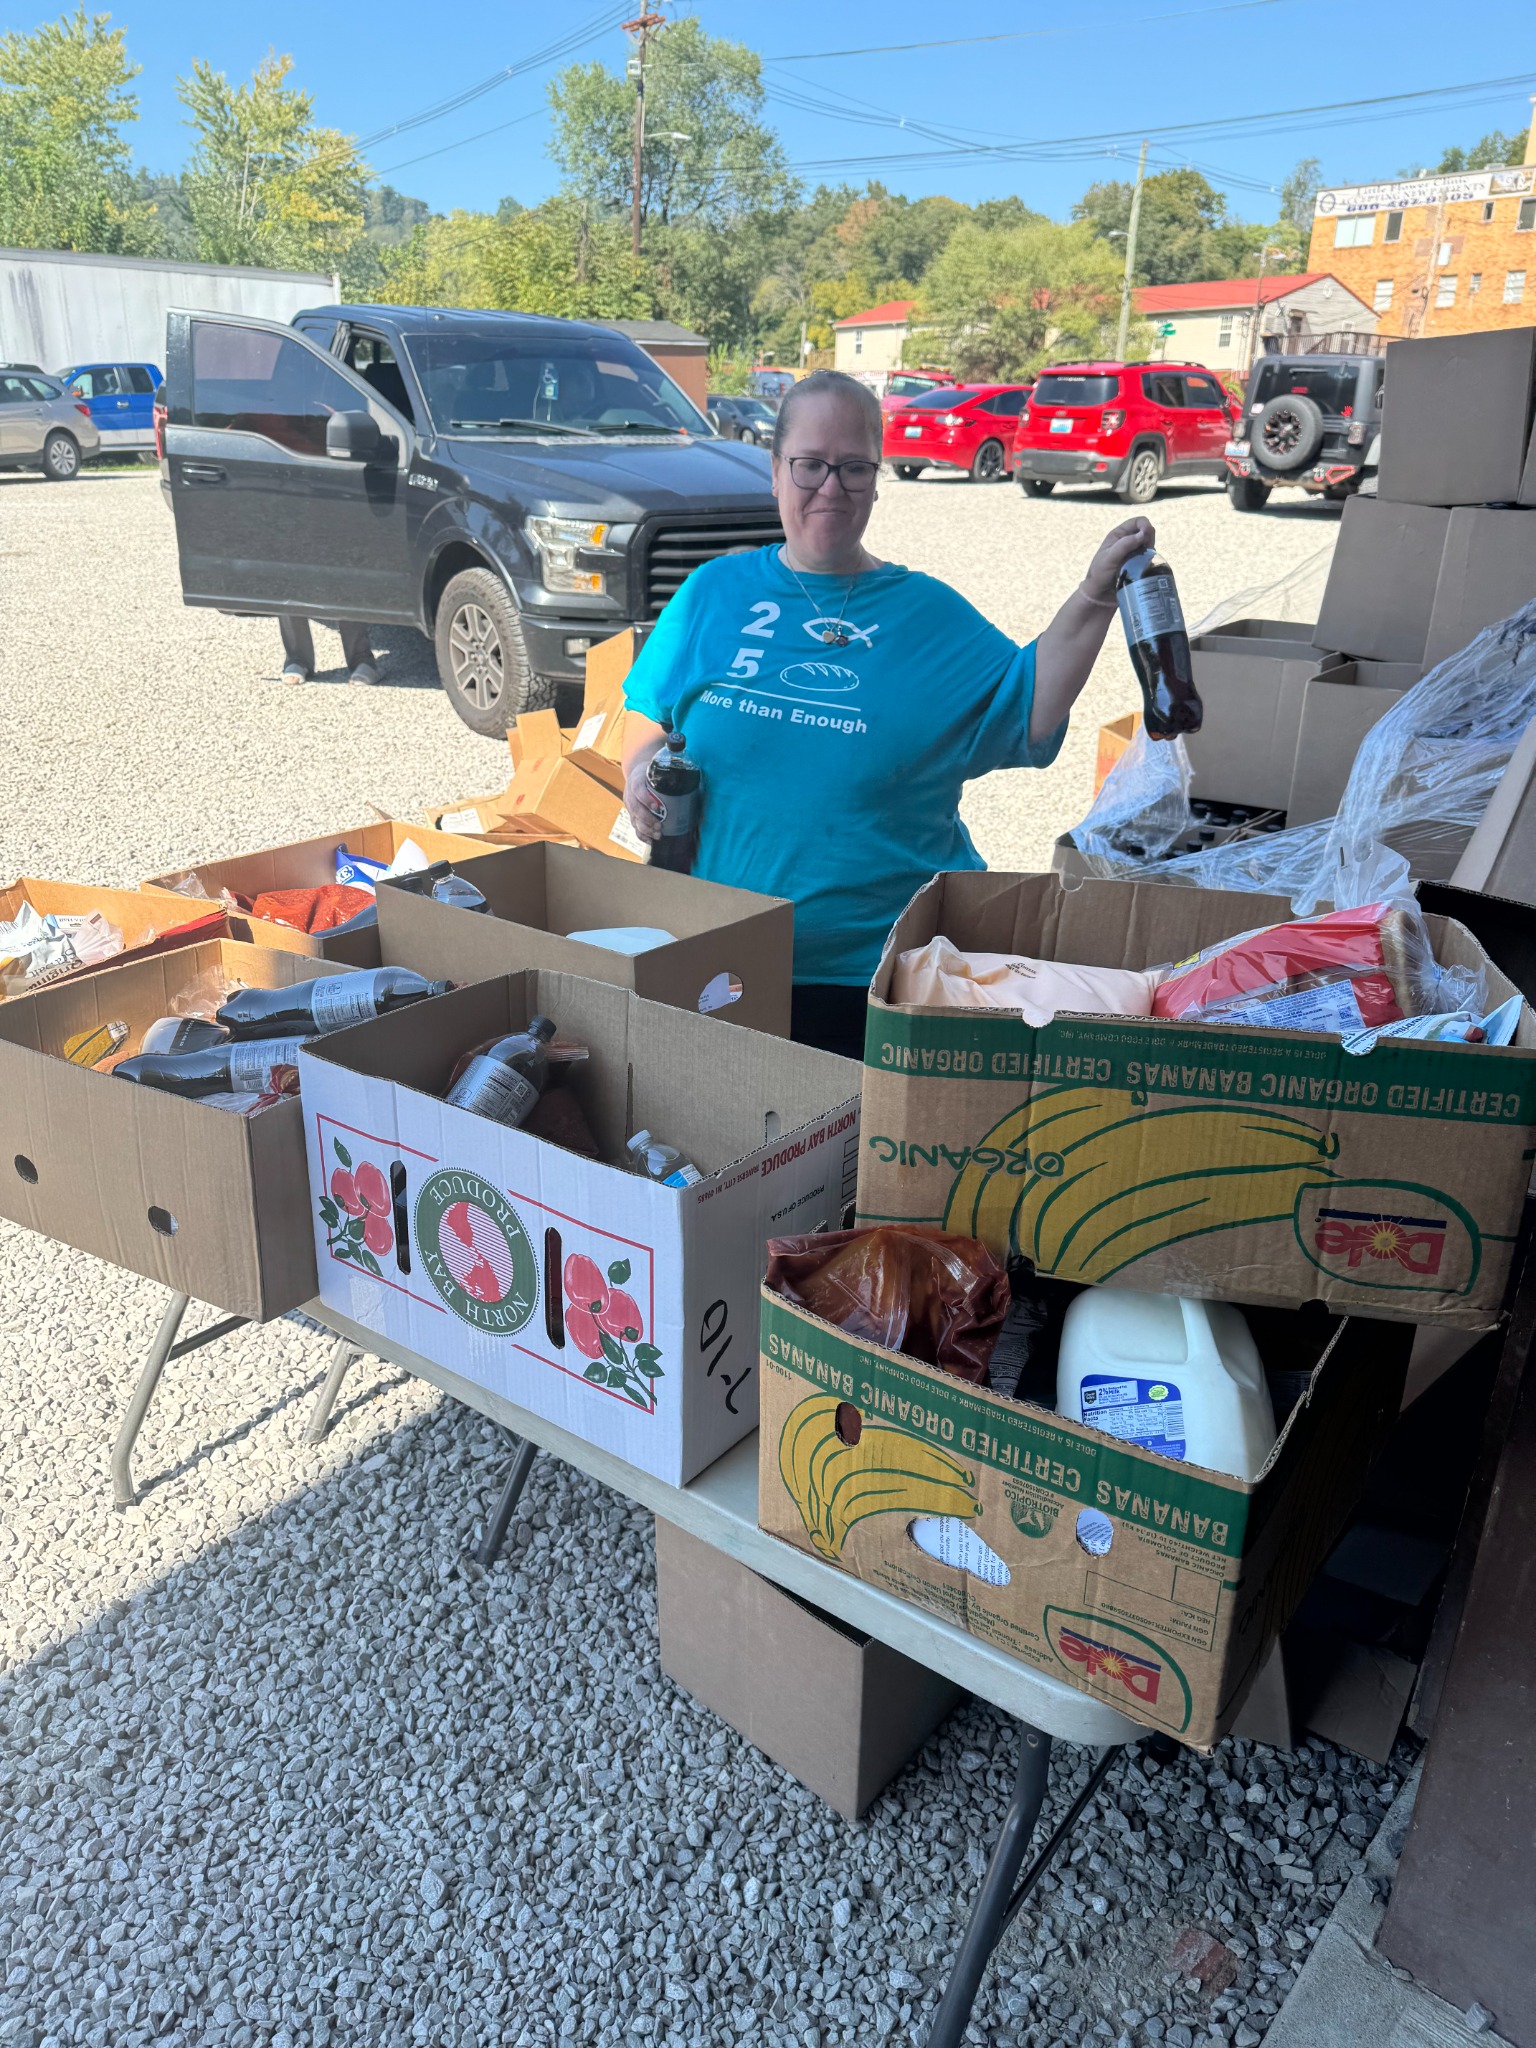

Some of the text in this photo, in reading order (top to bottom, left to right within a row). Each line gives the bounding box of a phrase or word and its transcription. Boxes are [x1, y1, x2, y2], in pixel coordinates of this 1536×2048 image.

[741, 601, 780, 638] 2
[726, 648, 764, 678] 5
[700, 690, 867, 733] More than Enough
[1177, 1038, 1229, 1052] TRADEMARK
[1231, 1043, 1283, 1057] REGISTERED
[880, 1043, 1112, 1083] CERTIFIED ORGANIC
[1126, 1061, 1521, 1117] CERTIFIED ORGANIC BANANAS
[826, 1110, 857, 1140] NORTH
[808, 1128, 825, 1151] BAY
[760, 1139, 807, 1177] PRODUCE
[870, 1135, 1064, 1177] ORGANIC
[427, 1175, 521, 1240] PRODUCE
[788, 1202, 797, 1212] OF
[797, 1185, 824, 1207] PRODUCE
[1315, 1218, 1445, 1276] Dole
[424, 1246, 530, 1333] NORTH BAY
[765, 1358, 792, 1381] 1100-01
[766, 1332, 854, 1396] BANANAS
[856, 1354, 872, 1366] INC.
[873, 1360, 910, 1382] COMPANY,
[911, 1377, 930, 1390] FOOD
[931, 1385, 949, 1399] DOLE
[858, 1381, 956, 1442] ORGANIC
[958, 1397, 1006, 1422] TRADEMARK
[1007, 1416, 1056, 1441] REGISTERED
[1065, 1438, 1074, 1447] IS
[1076, 1442, 1097, 1457] DOLE
[960, 1425, 1083, 1493] CERTIFIED
[1005, 1489, 1059, 1517] BIOTROPICO
[1094, 1479, 1229, 1548] BANANAS
[1137, 1536, 1176, 1553] COLOMBIA
[1155, 1550, 1224, 1577] ORGANIC BANANAS
[1191, 1555, 1225, 1570] PRODUCT
[1212, 1555, 1226, 1563] NET
[982, 1608, 1009, 1626] Organic
[1169, 1617, 1209, 1635] GGN FARM:
[1181, 1610, 1210, 1624] REG ICA:
[1011, 1623, 1040, 1641] Certified
[1024, 1645, 1053, 1663] Address
[1058, 1632, 1161, 1704] Dole
